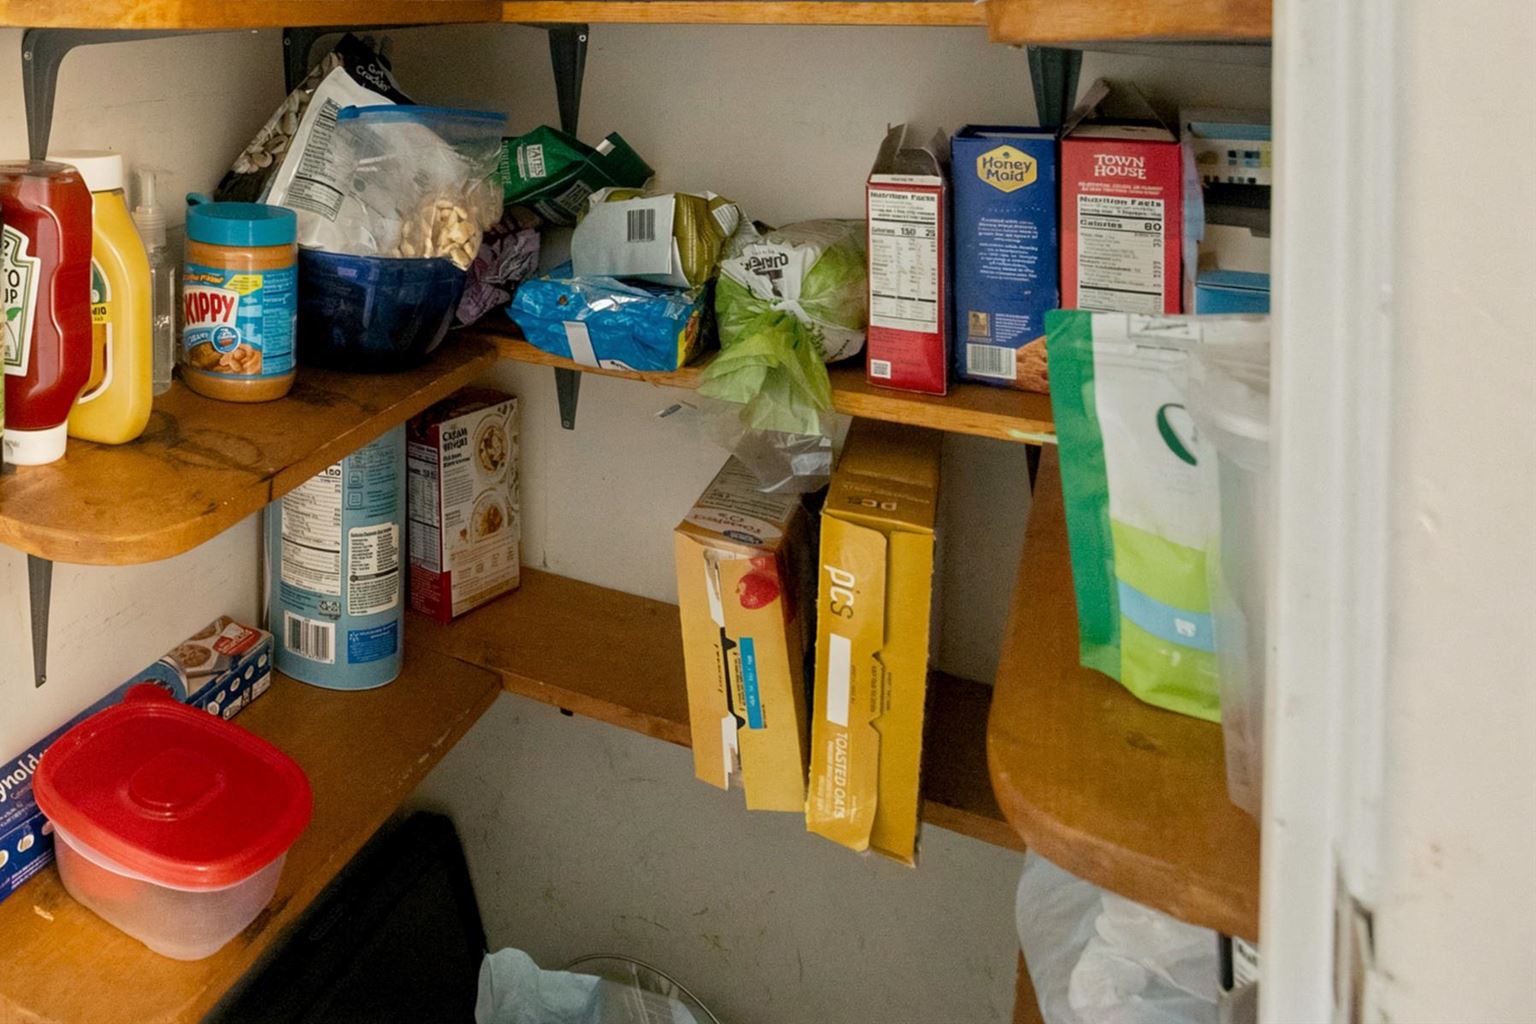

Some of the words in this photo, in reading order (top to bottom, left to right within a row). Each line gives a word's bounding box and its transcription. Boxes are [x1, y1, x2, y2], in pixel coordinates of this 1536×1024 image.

[982, 156, 1032, 173] Honey
[1094, 154, 1145, 167] TOWN
[986, 169, 1025, 182] Maid
[1094, 165, 1146, 179] HOUSE
[1080, 219, 1123, 229] Calories
[1144, 222, 1162, 231] 80
[184, 291, 235, 326] KIPPY
[442, 428, 468, 442] CREAM
[834, 732, 849, 786] TOASTED
[833, 787, 847, 819] OATS
